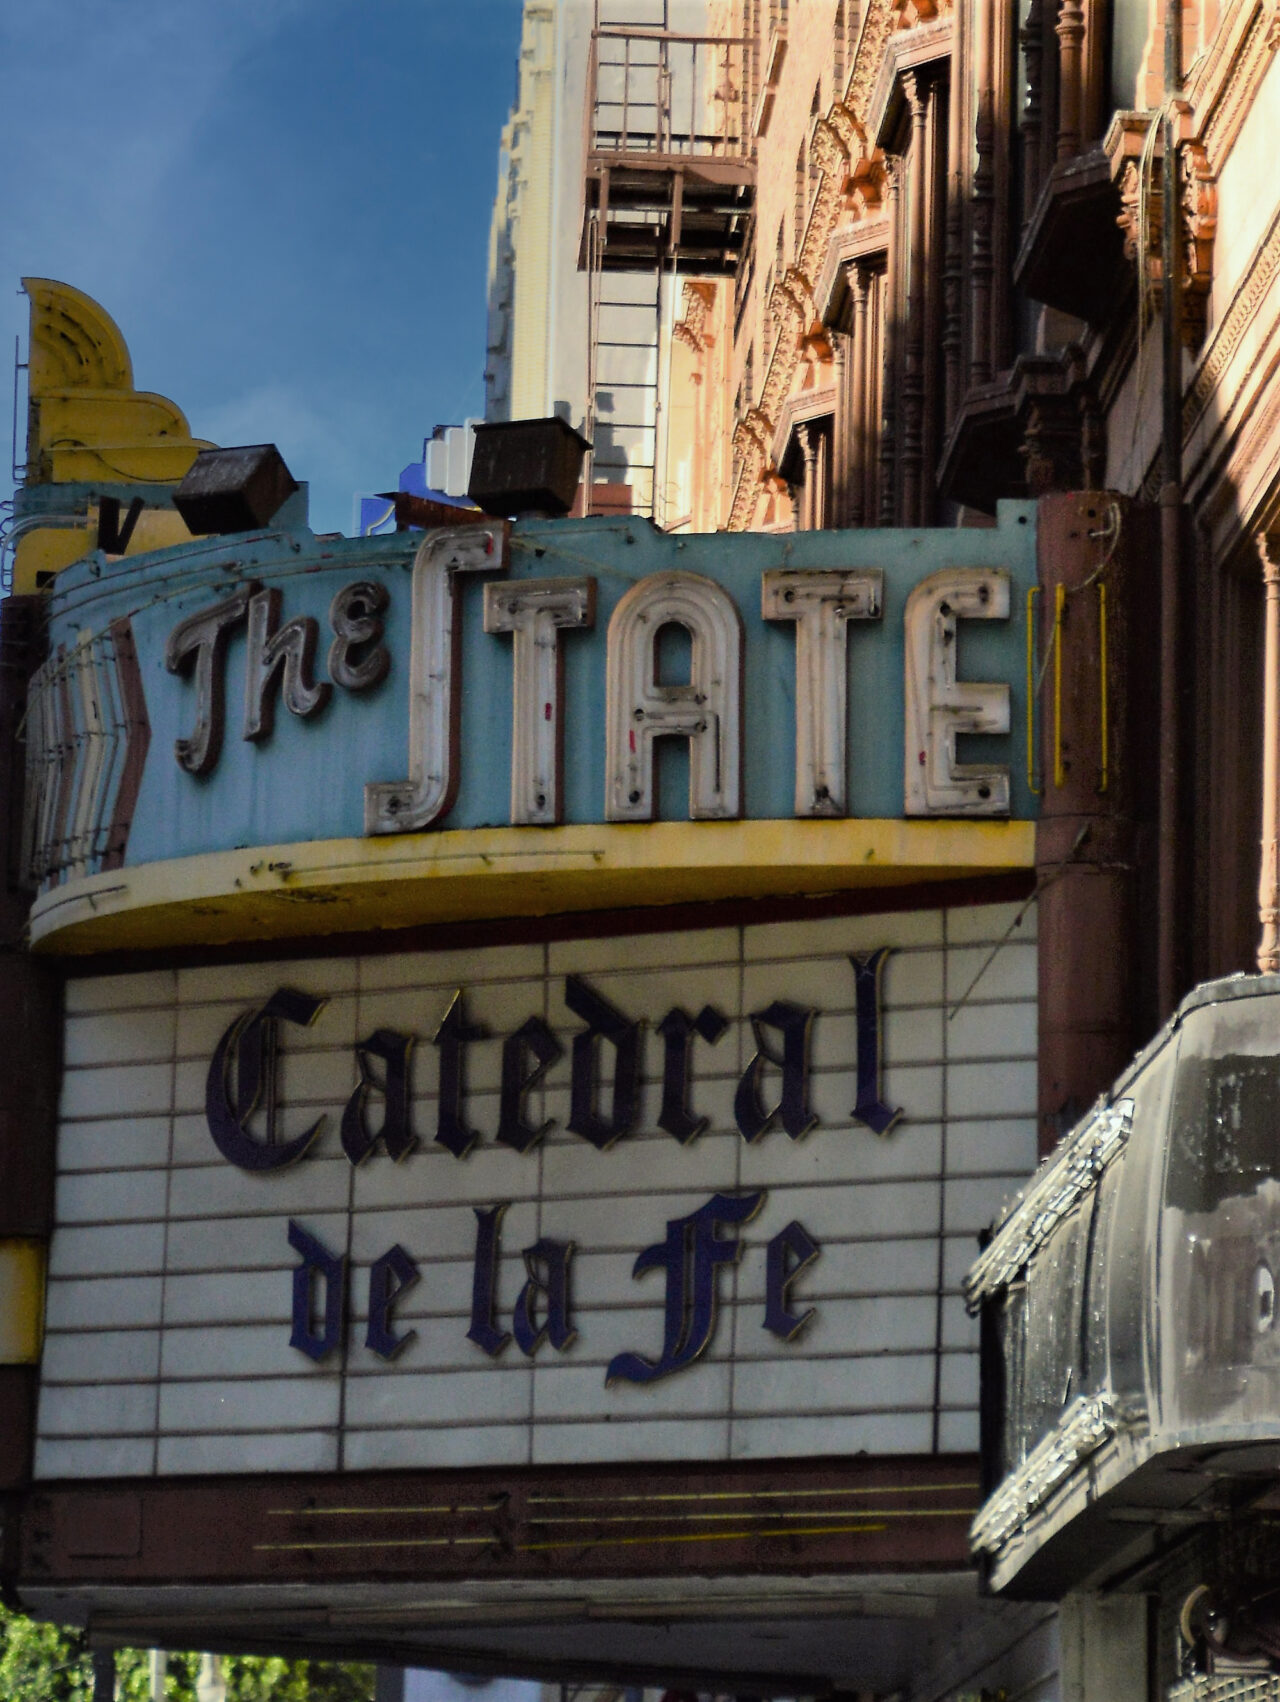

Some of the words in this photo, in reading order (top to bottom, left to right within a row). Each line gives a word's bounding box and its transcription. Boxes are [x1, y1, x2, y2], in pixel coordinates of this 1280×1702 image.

[166, 577, 389, 776] The
[364, 520, 1011, 835] STATE
[204, 947, 906, 1172] Catedral
[286, 1218, 422, 1362] de
[465, 1202, 579, 1357] la
[605, 1189, 824, 1389] Fe
